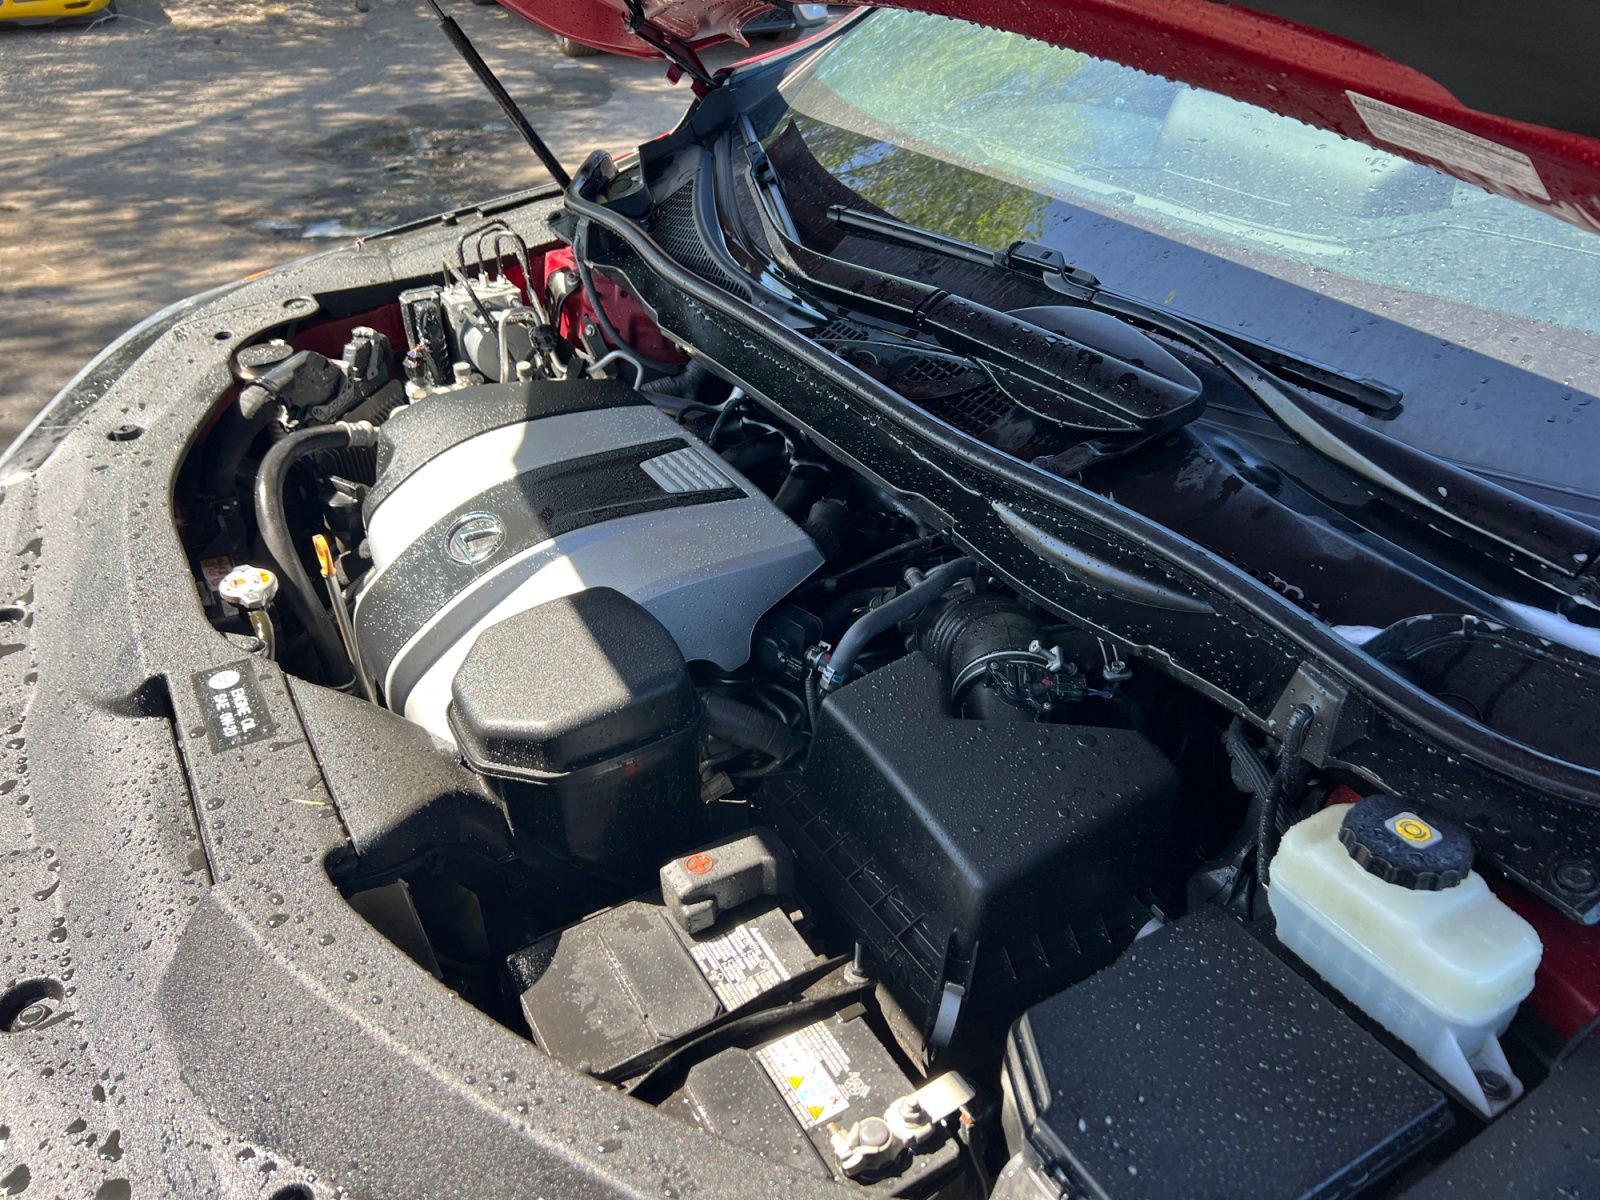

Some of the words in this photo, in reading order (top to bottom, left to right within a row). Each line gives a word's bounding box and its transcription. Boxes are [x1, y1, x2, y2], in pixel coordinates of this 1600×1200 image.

[213, 693, 230, 711] SAE
[230, 687, 252, 717] ENGINE
[240, 718, 256, 733] OIL
